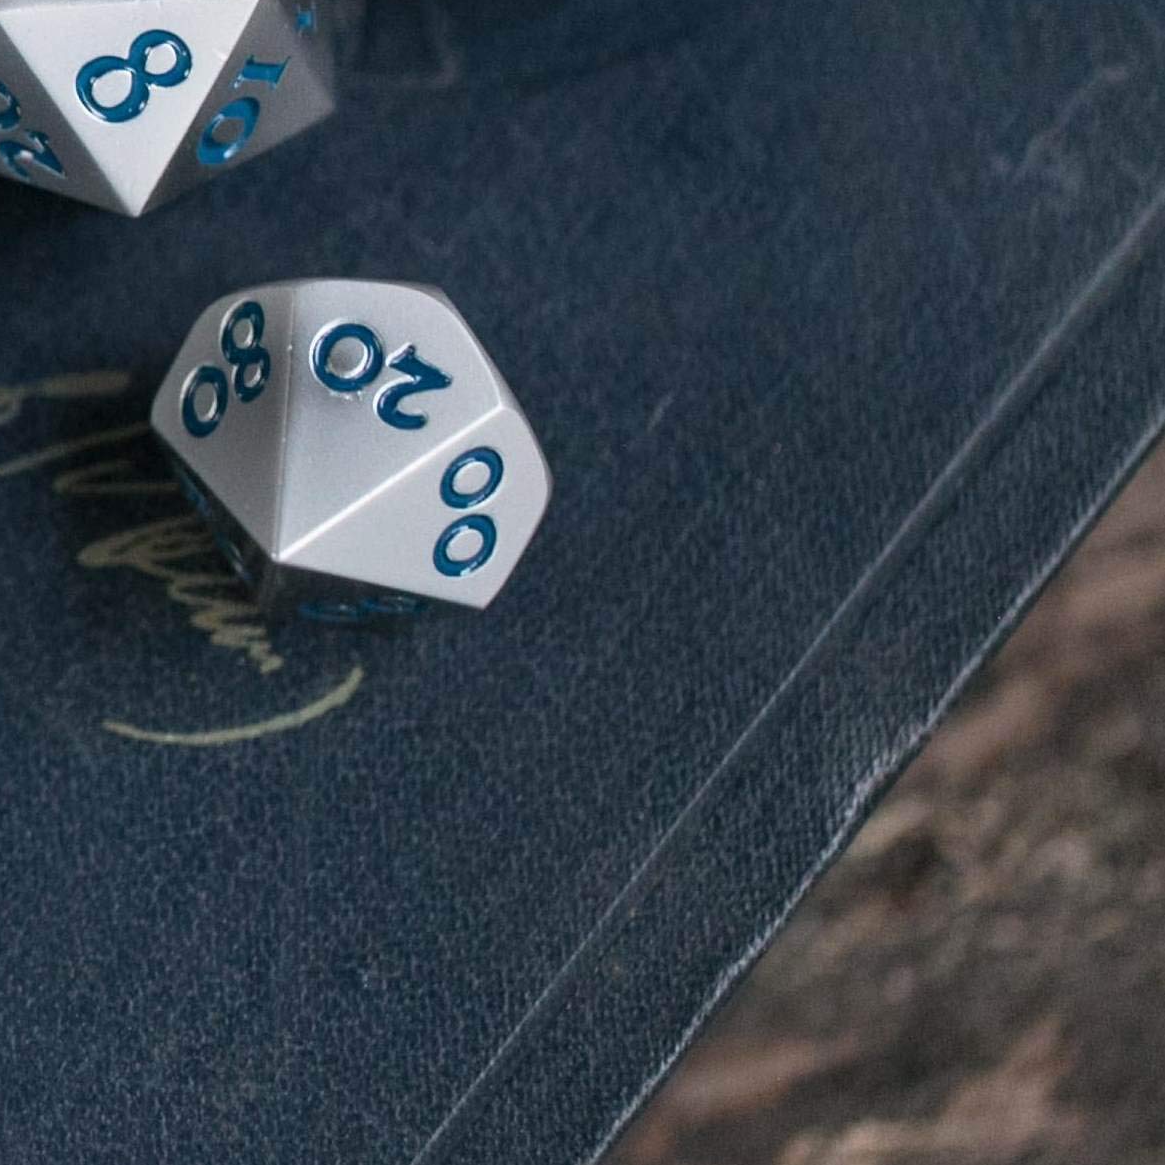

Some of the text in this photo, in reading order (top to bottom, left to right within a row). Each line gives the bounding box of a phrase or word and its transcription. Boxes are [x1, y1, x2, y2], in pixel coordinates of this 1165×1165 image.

[74, 28, 193, 125] 8
[196, 53, 292, 167] 10
[180, 300, 272, 439] 80
[308, 318, 455, 432] 20
[432, 445, 506, 578] 00
